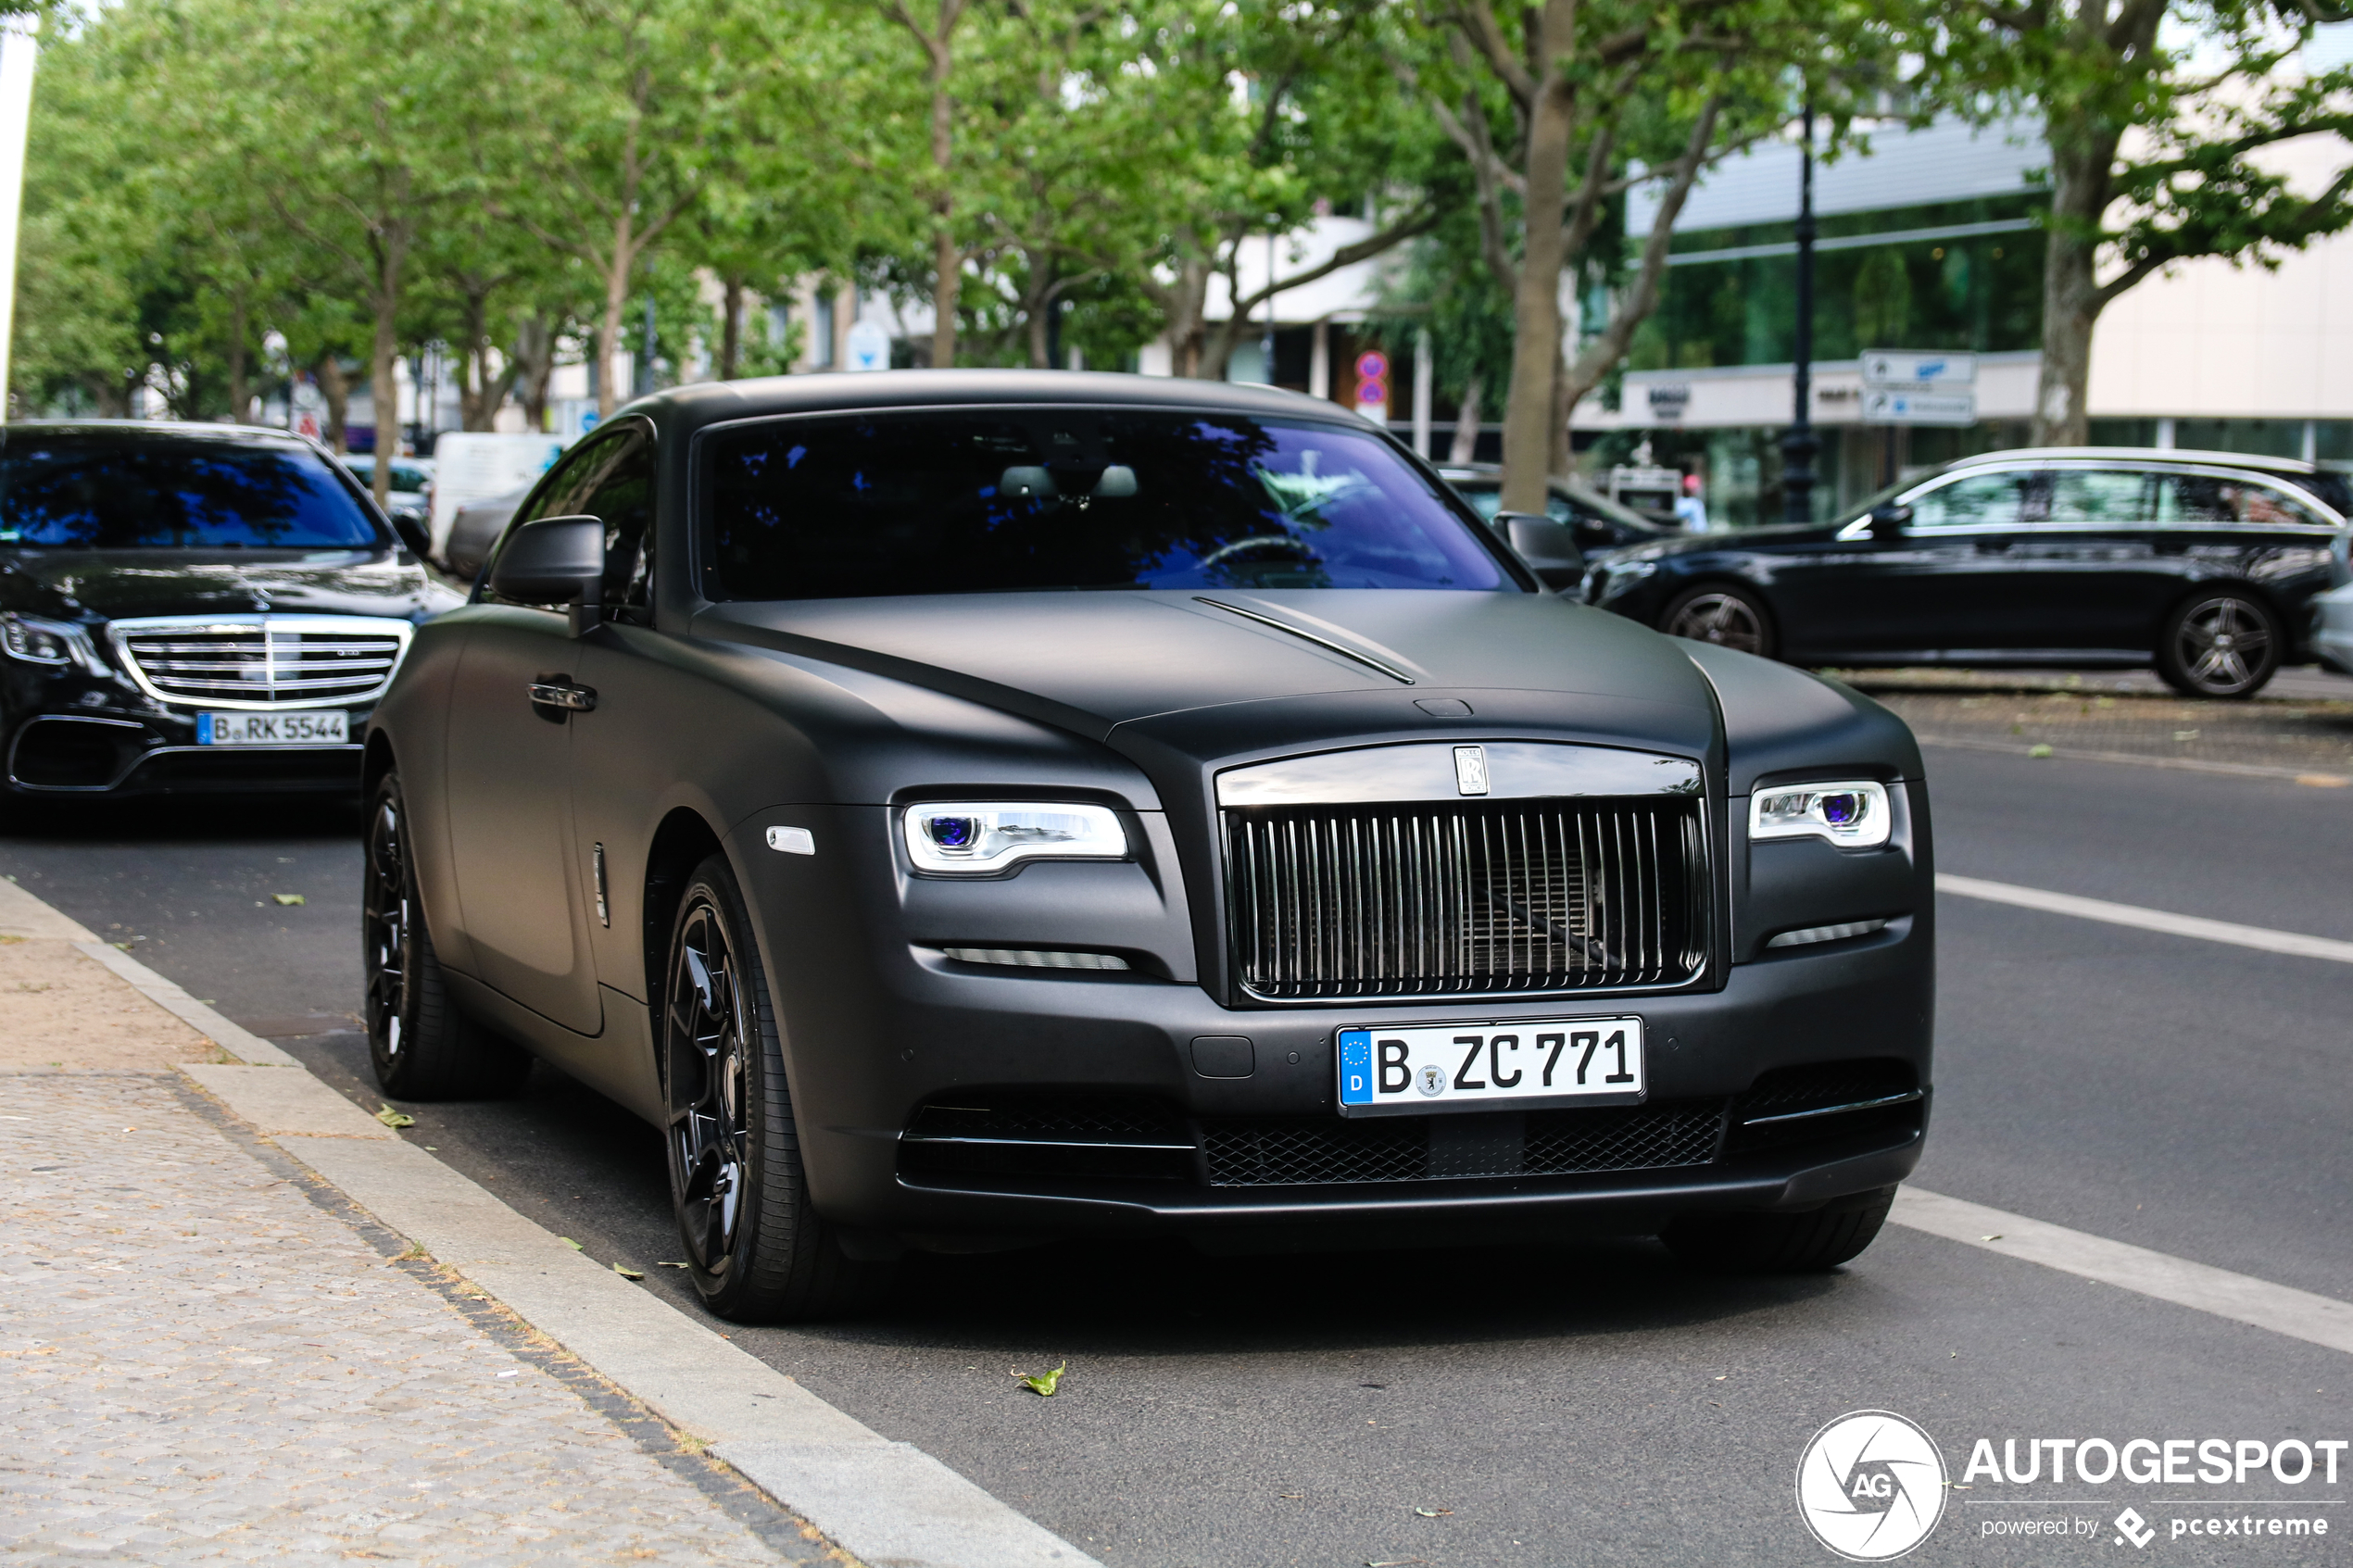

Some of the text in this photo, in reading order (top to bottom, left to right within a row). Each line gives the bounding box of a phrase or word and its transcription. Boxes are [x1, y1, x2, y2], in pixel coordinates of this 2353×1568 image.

[215, 717, 343, 739] B RK 5544
[1378, 1030, 1634, 1094] B ZC 771
[1351, 1075, 1363, 1091] D
